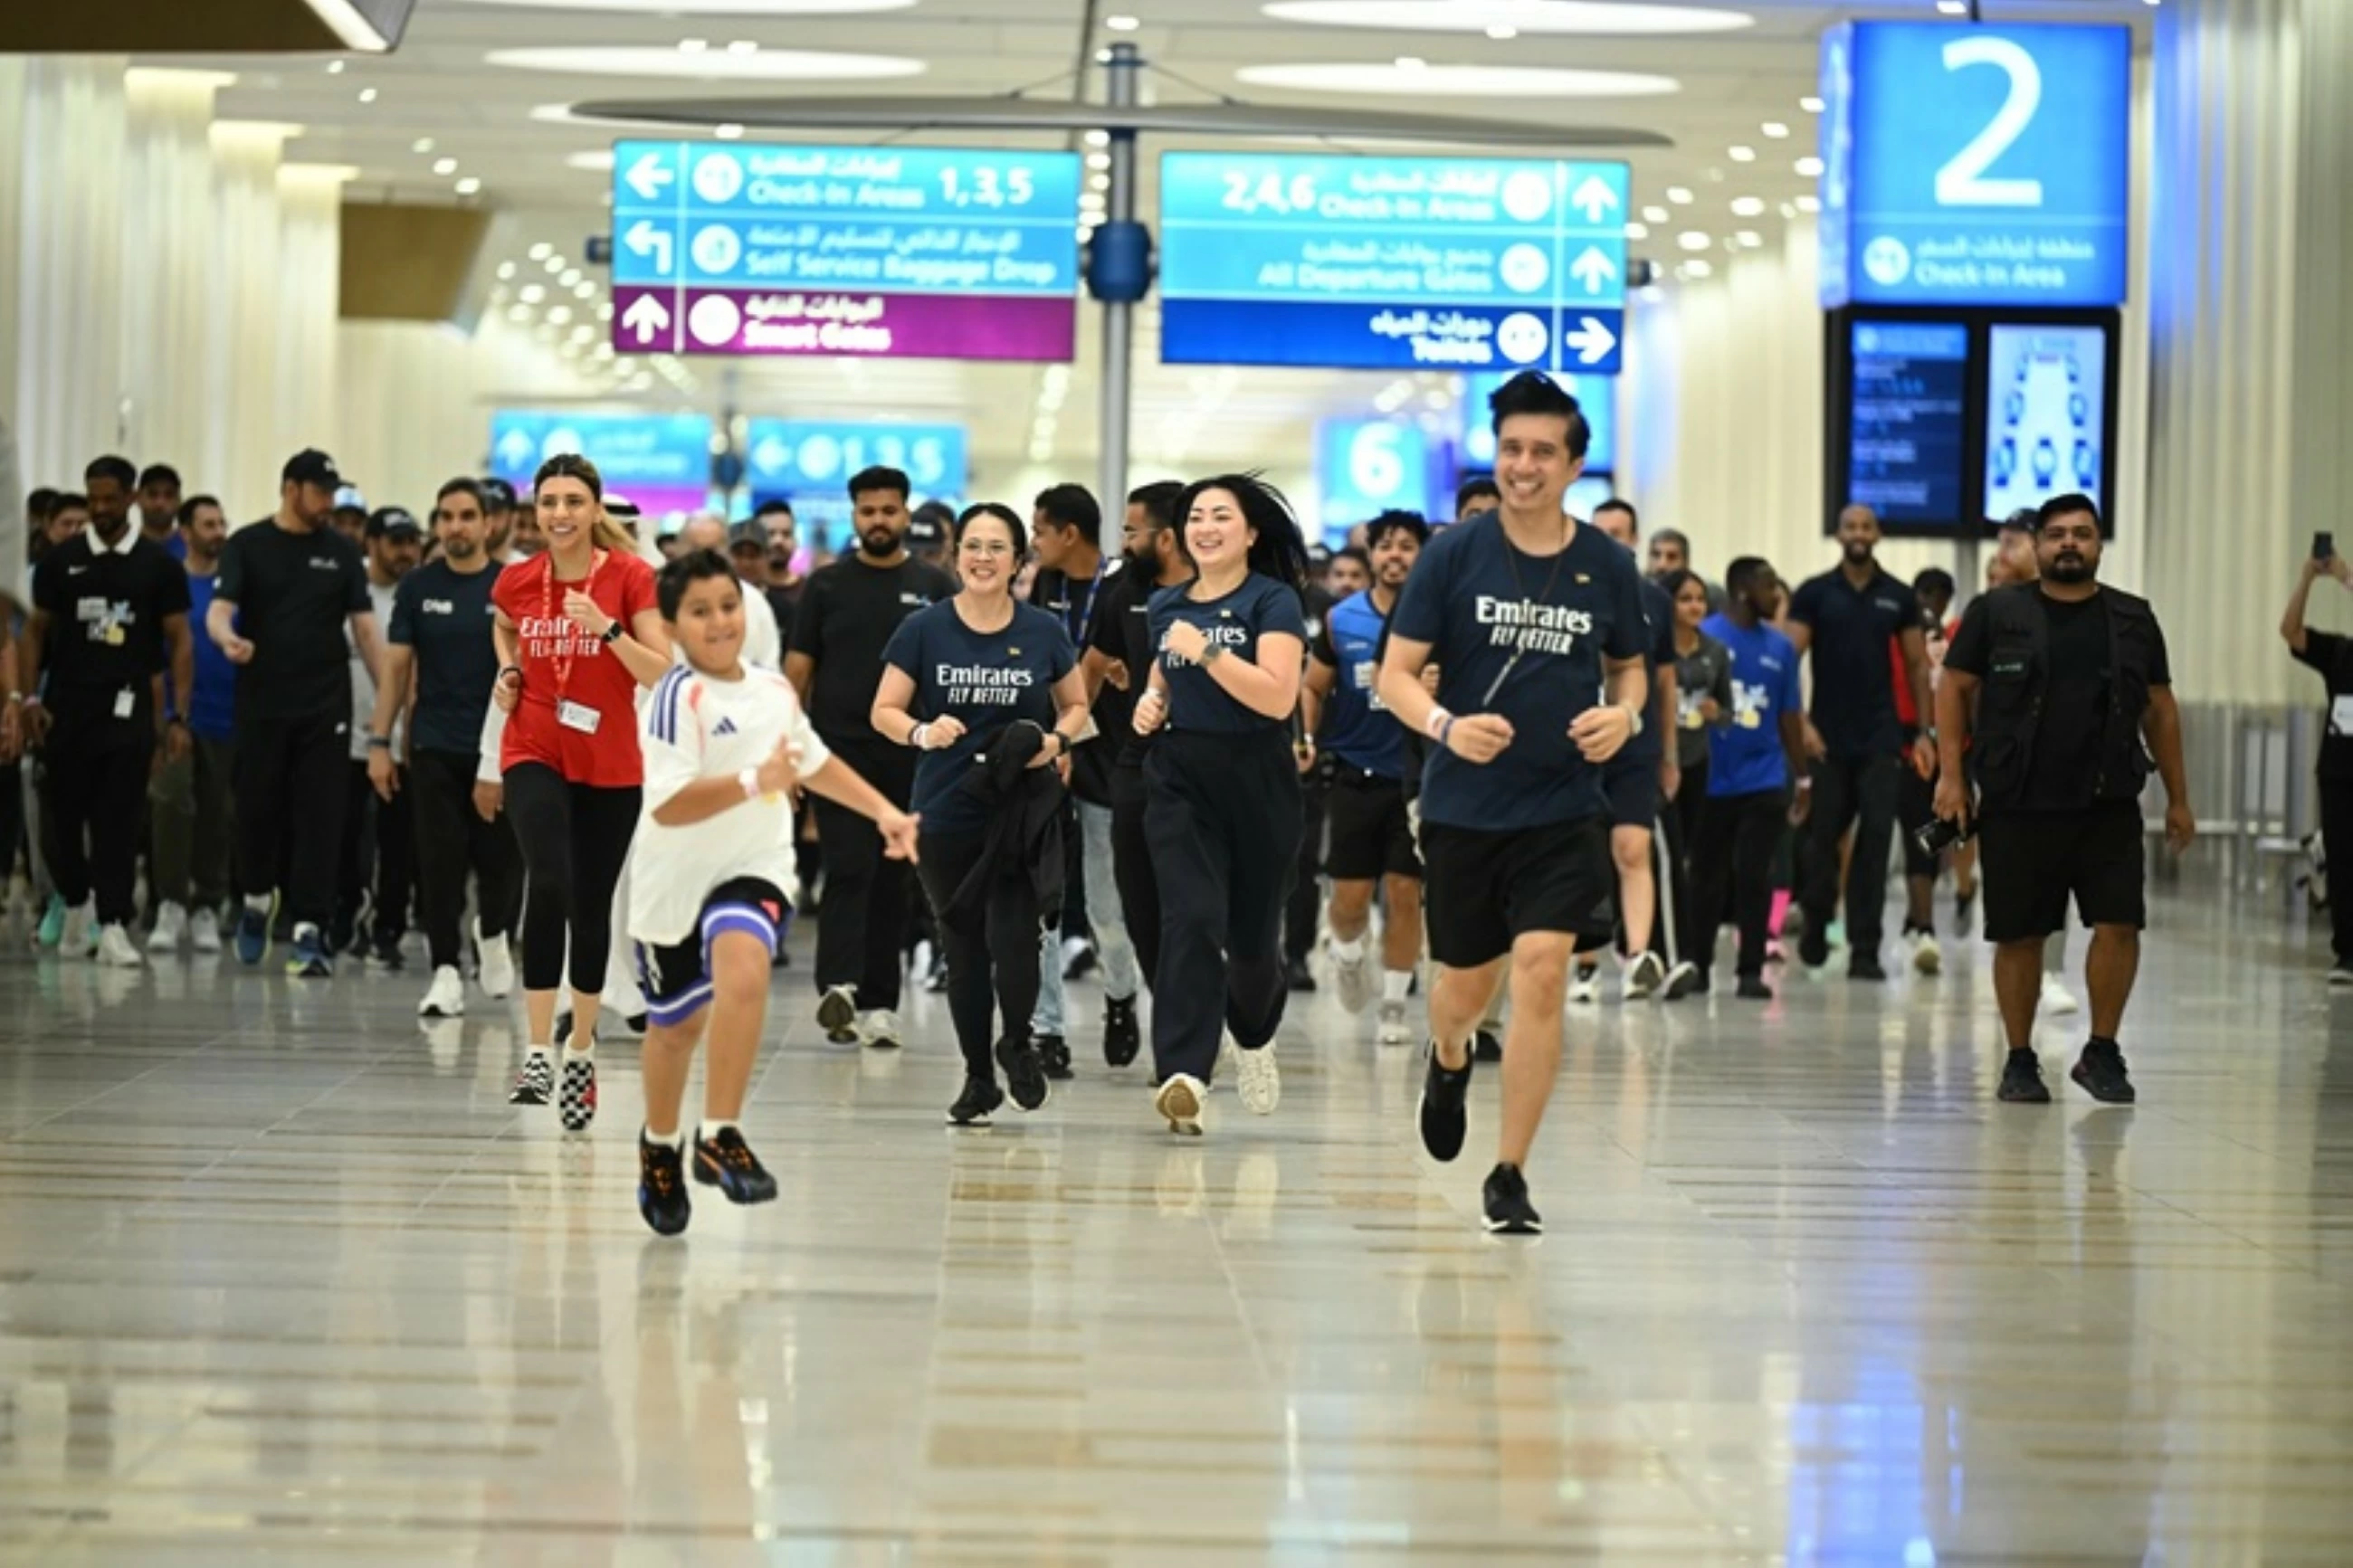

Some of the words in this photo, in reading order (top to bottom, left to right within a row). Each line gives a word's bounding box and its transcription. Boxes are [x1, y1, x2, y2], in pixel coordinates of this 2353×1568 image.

[1934, 36, 2043, 207] 2
[854, 182, 926, 209] Areas
[1427, 195, 1495, 221] Areas
[745, 250, 793, 277] Self
[795, 252, 880, 279] Service
[882, 254, 992, 287] Baggage
[993, 256, 1058, 286] Drop
[1298, 261, 1420, 291] Departure
[2012, 261, 2066, 290] Area
[819, 322, 892, 352] Gates
[1348, 421, 1404, 499] 6
[1475, 594, 1594, 634] Emirates
[935, 663, 1034, 686] Emirates
